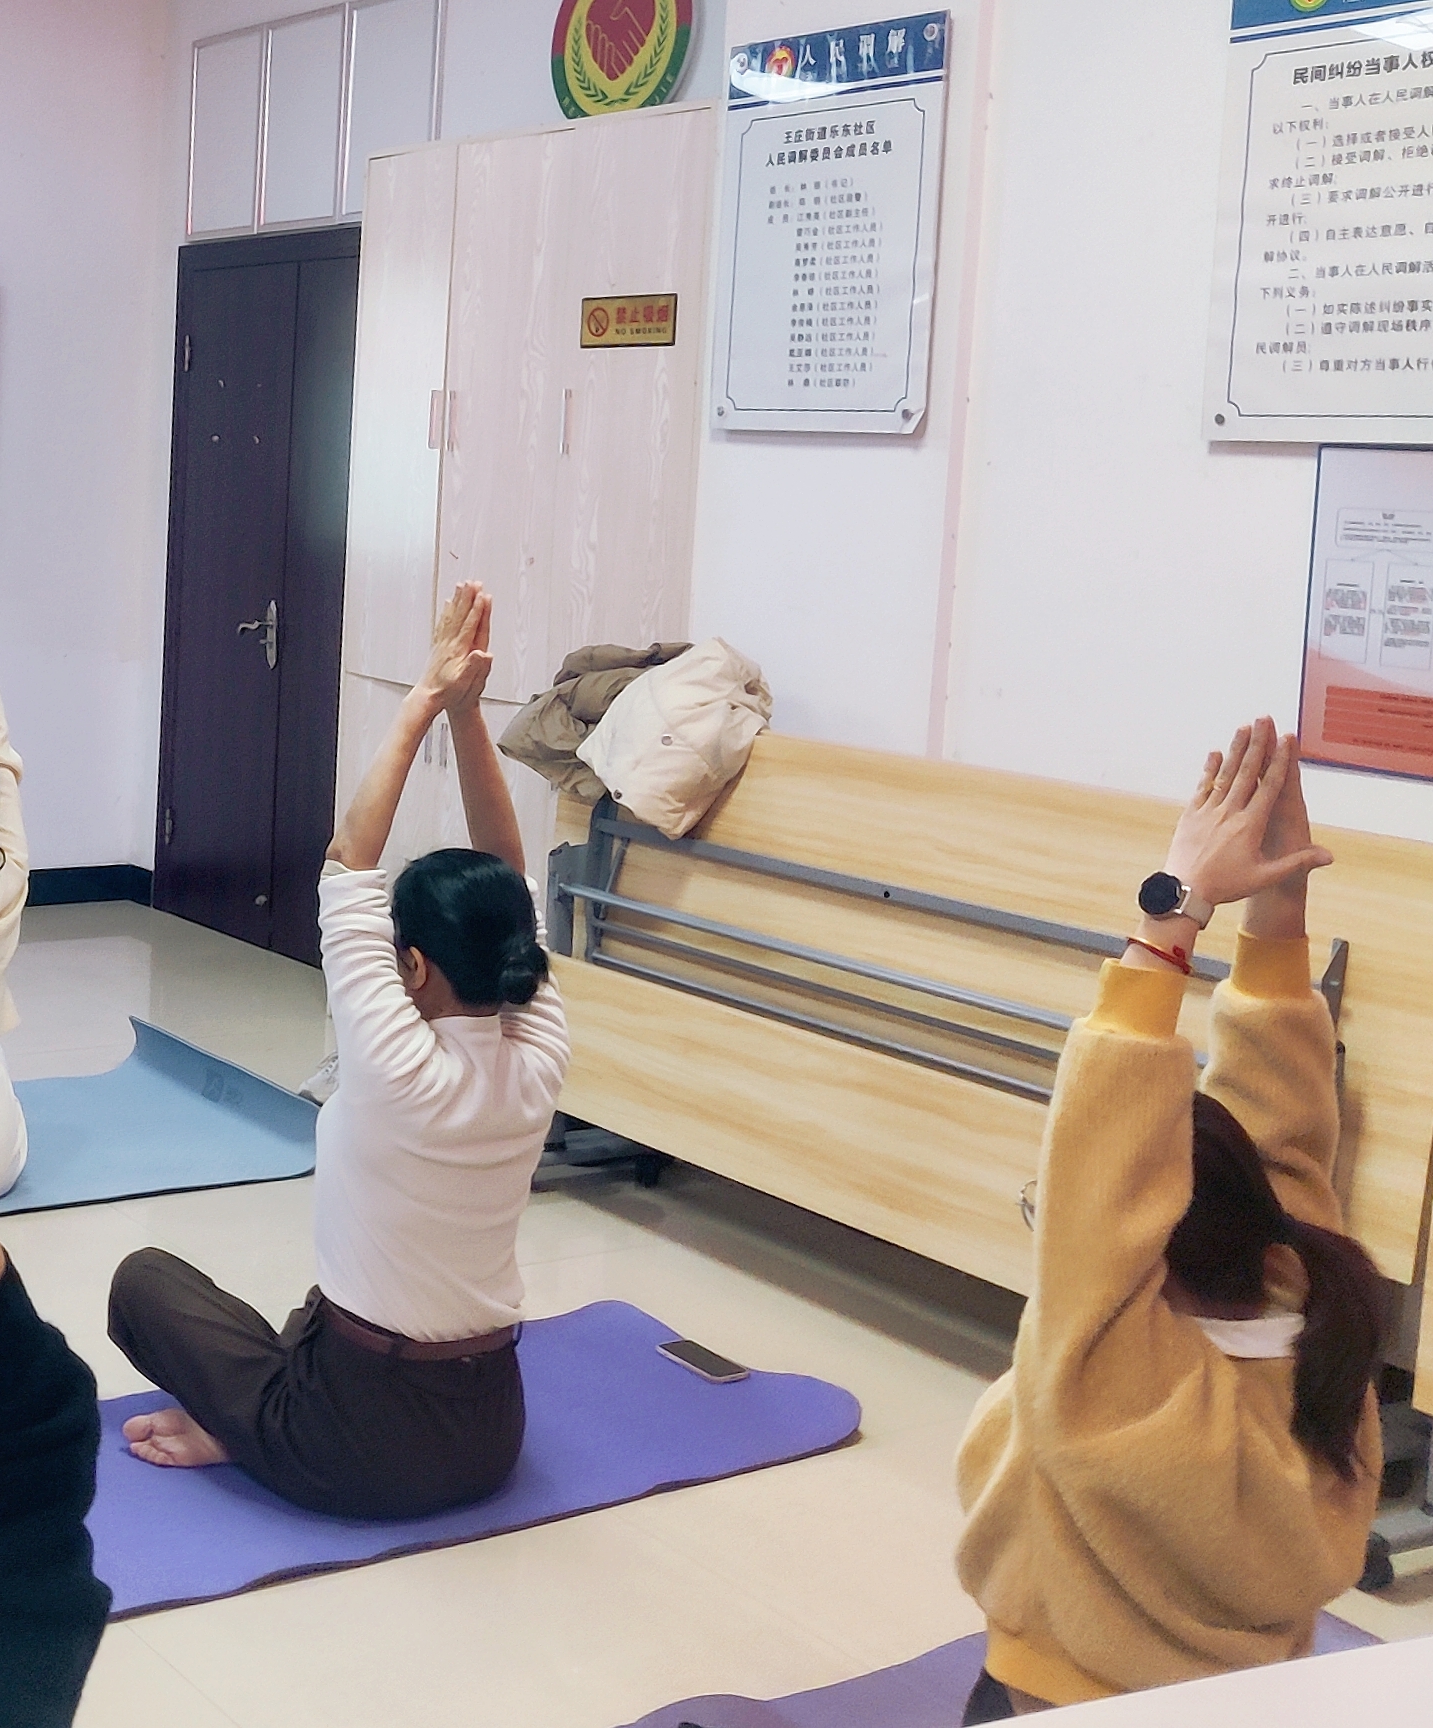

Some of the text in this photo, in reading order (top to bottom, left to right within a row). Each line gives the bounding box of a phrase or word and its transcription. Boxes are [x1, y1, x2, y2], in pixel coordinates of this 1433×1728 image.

[1292, 51, 1433, 86] 民间纠纷当事人权
[784, 120, 876, 145] 王庄街道乐东社区
[1296, 124, 1433, 151] （一）选择或者接受人
[765, 140, 893, 167] 人民调解委员会成员名单
[1295, 143, 1433, 170] （二）接受调解、拒绝
[615, 304, 669, 325] 禁止吸烟
[630, 327, 667, 335] SMOKING
[1282, 357, 1433, 373] （三）尊重对方当事人行
